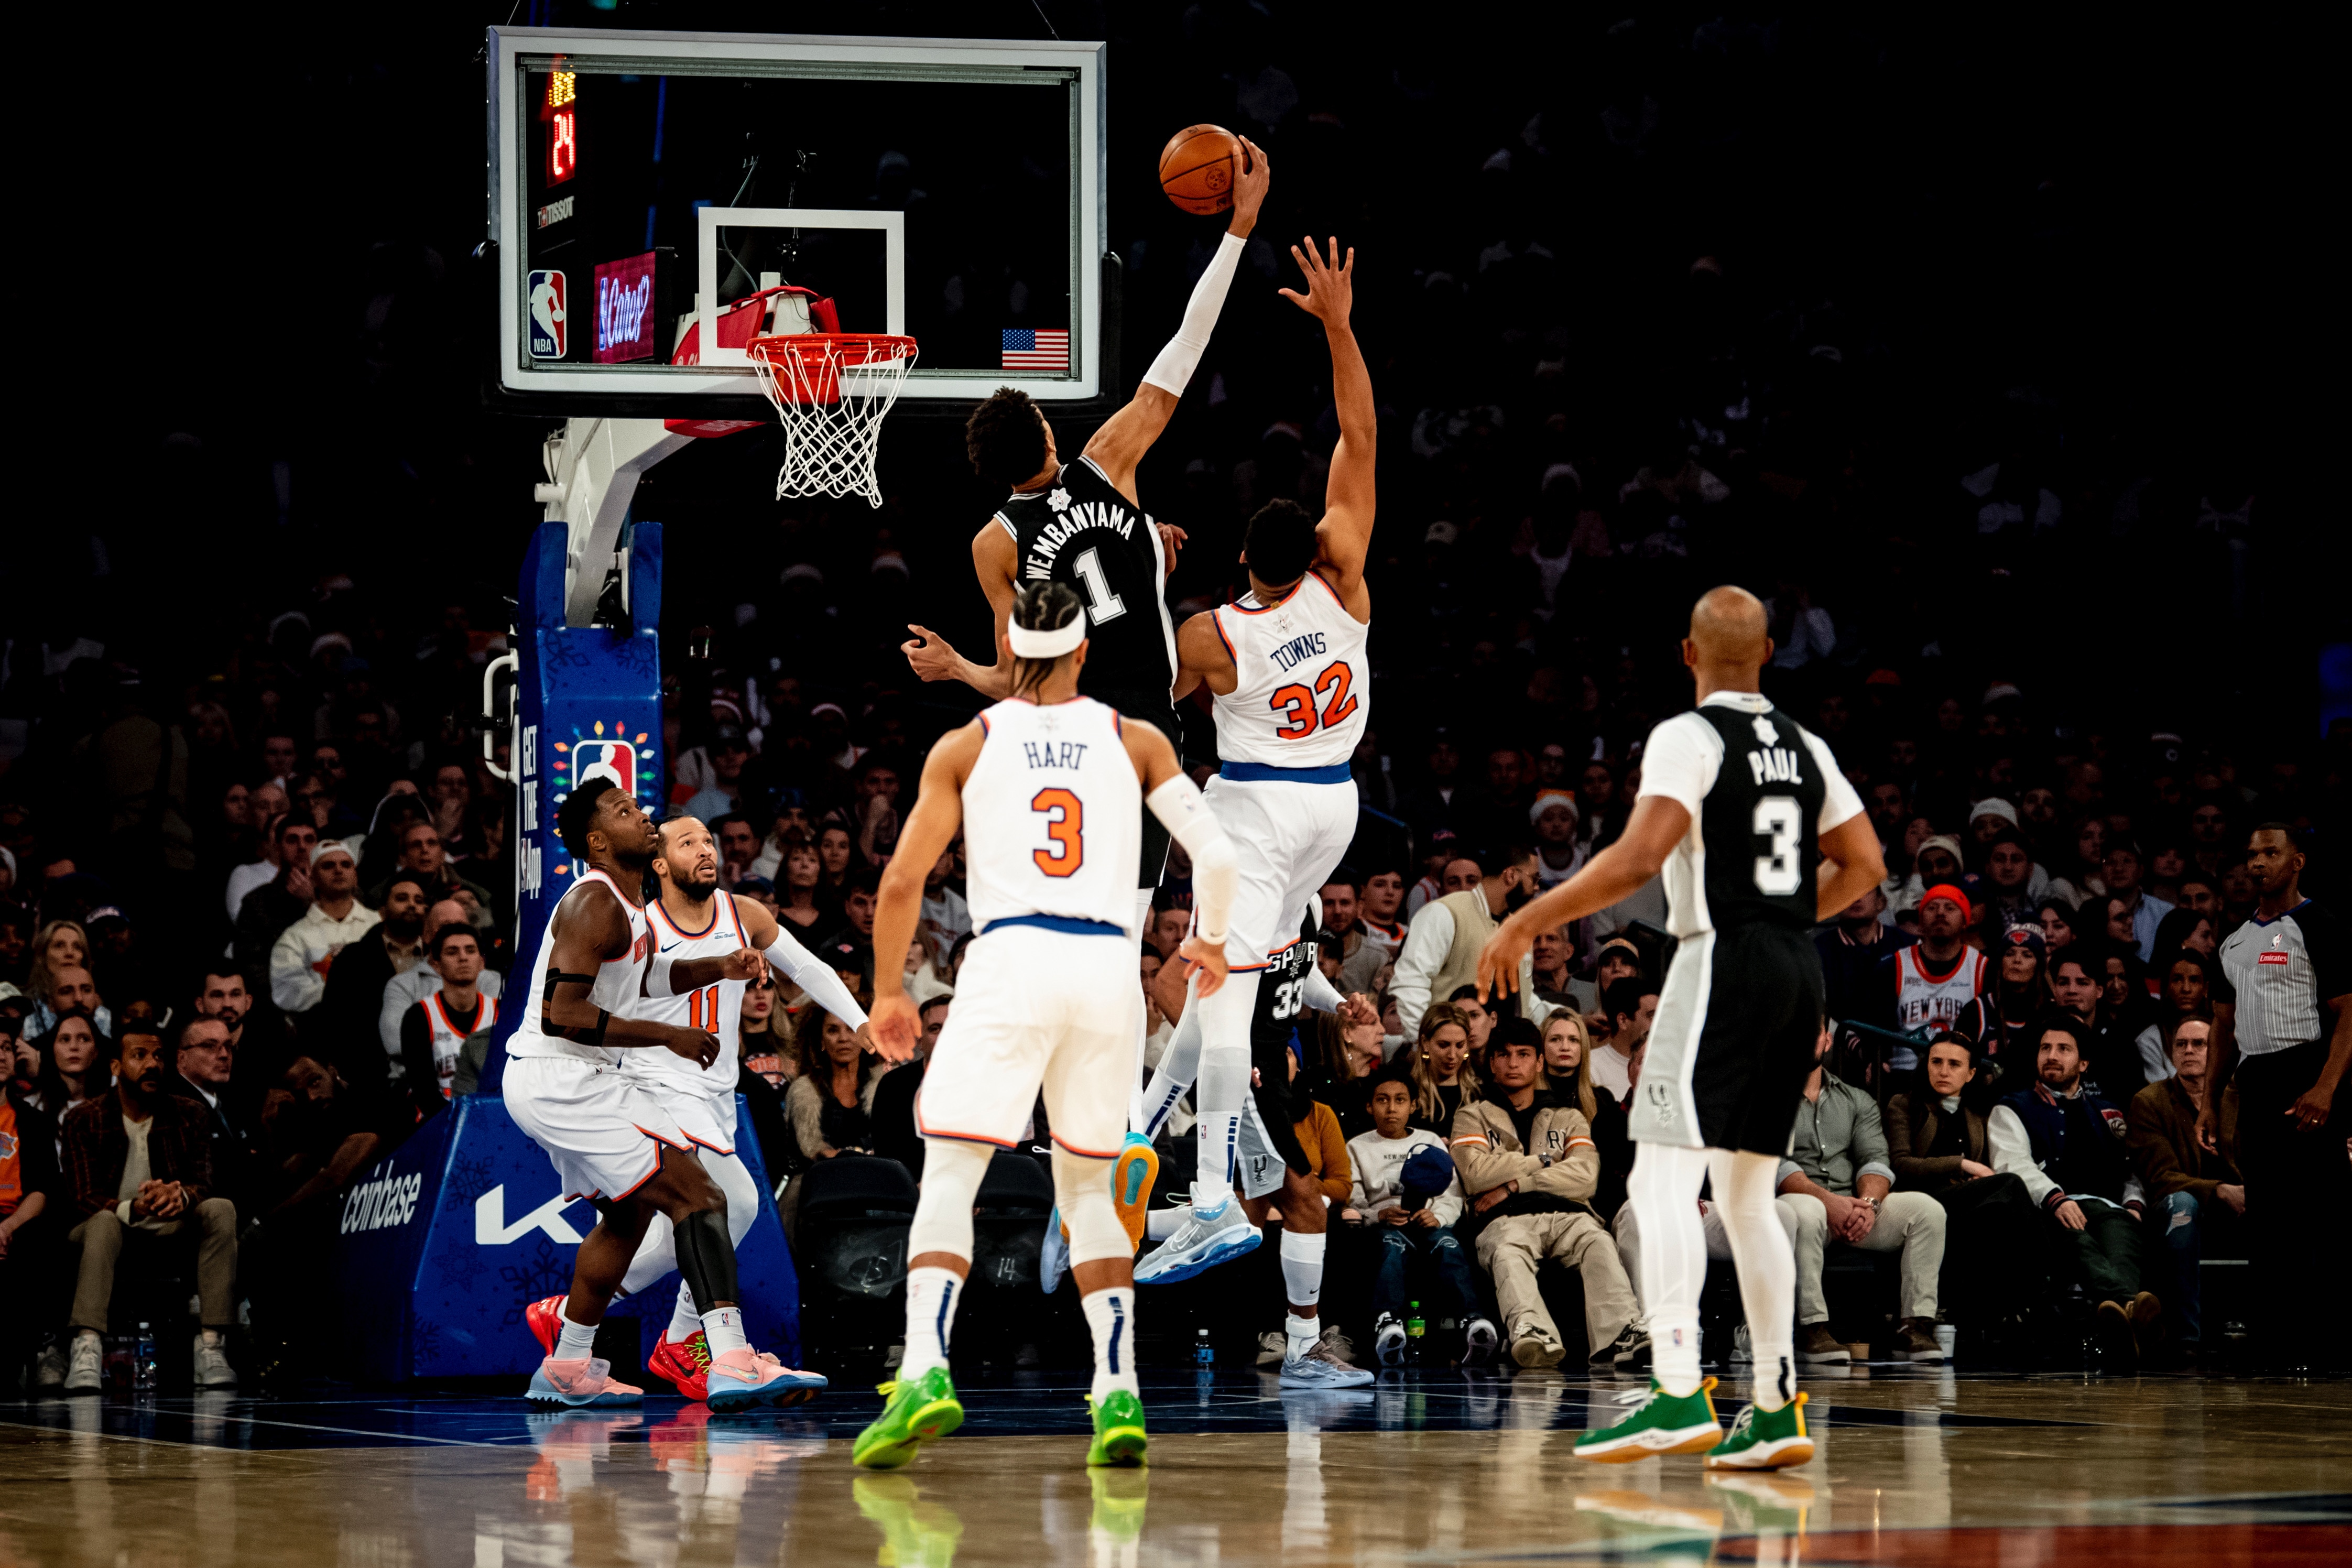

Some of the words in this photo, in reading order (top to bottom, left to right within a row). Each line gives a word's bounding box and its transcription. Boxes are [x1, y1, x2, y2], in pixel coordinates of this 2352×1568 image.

[553, 113, 575, 175] 24
[607, 277, 643, 348] Cares
[534, 339, 552, 353] NBA
[1026, 502, 1135, 580] WEMBANYAMA
[1073, 546, 1127, 626] 1
[1270, 632, 1326, 672] TOWNS
[1269, 660, 1359, 740] 32
[1023, 741, 1088, 770] HART
[1747, 747, 1803, 786] PAUL
[1031, 787, 1083, 878] 3
[1752, 796, 1803, 896] 3
[1265, 942, 1316, 975] SPUR
[2260, 953, 2287, 962] Emirates
[688, 985, 720, 1035] 11
[1271, 976, 1306, 1020] 33
[1899, 997, 1930, 1023] NEW
[1935, 997, 1964, 1020] YOR
[341, 1159, 421, 1234] coinbase
